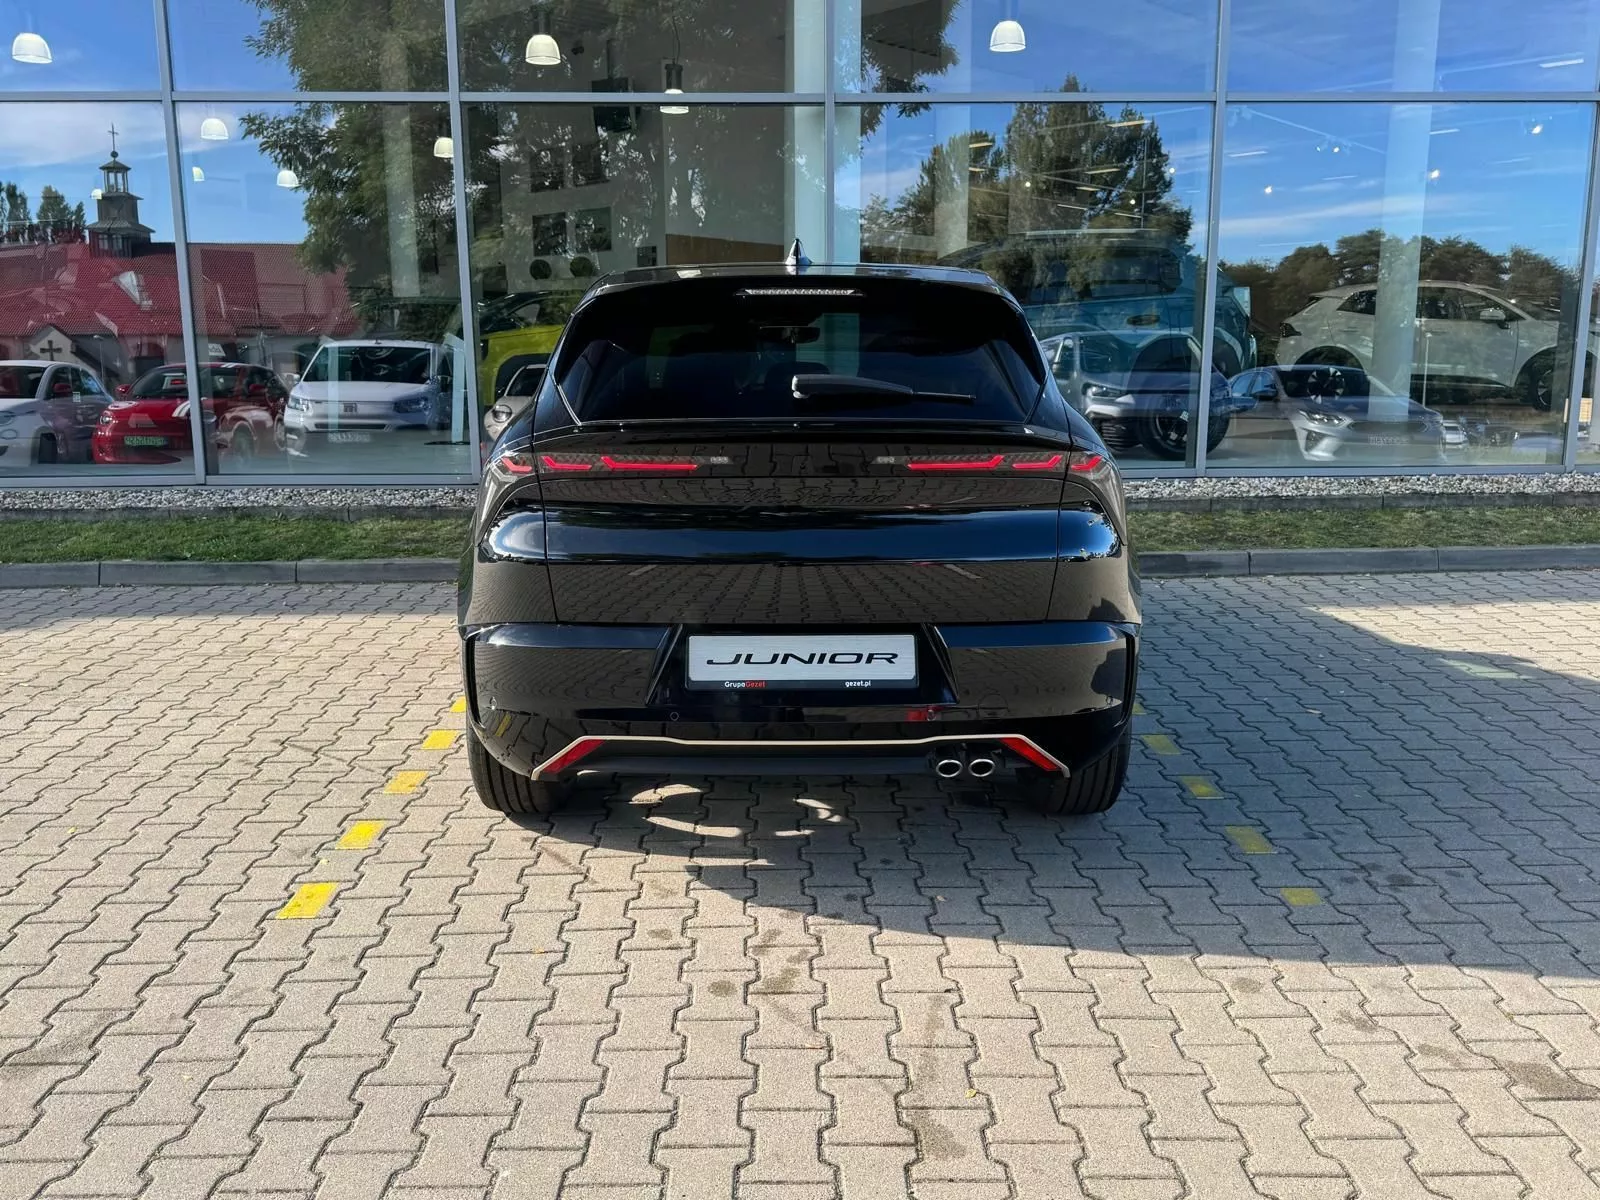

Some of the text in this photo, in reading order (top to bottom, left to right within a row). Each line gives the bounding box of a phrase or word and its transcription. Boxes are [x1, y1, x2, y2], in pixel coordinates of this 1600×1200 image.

[706, 652, 899, 665] JUNIOR
[724, 680, 766, 689] GrupaGezet
[844, 679, 872, 688] gezet.pl
